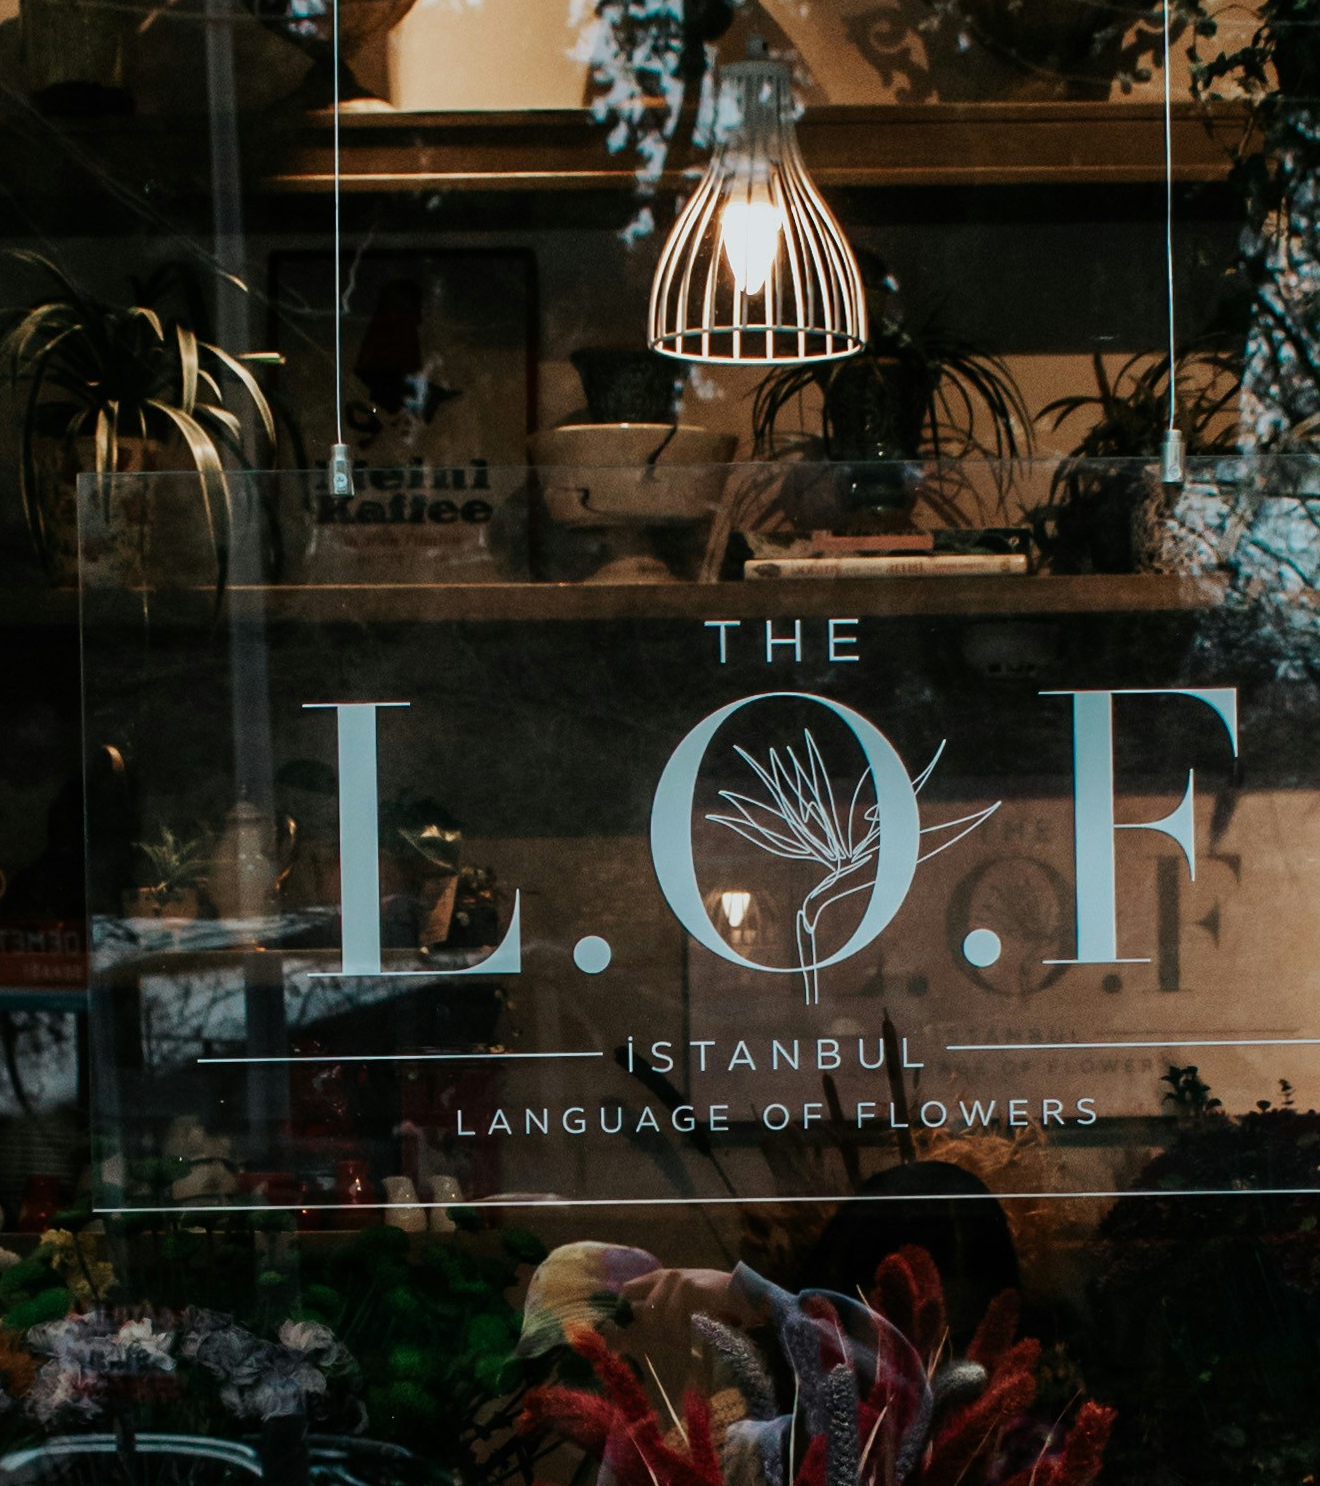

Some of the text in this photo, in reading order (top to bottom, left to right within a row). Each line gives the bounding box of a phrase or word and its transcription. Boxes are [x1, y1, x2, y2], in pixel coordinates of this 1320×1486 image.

[703, 617, 862, 664] THE
[456, 1096, 1098, 1137] LANGUAGE OF FLOWERS
